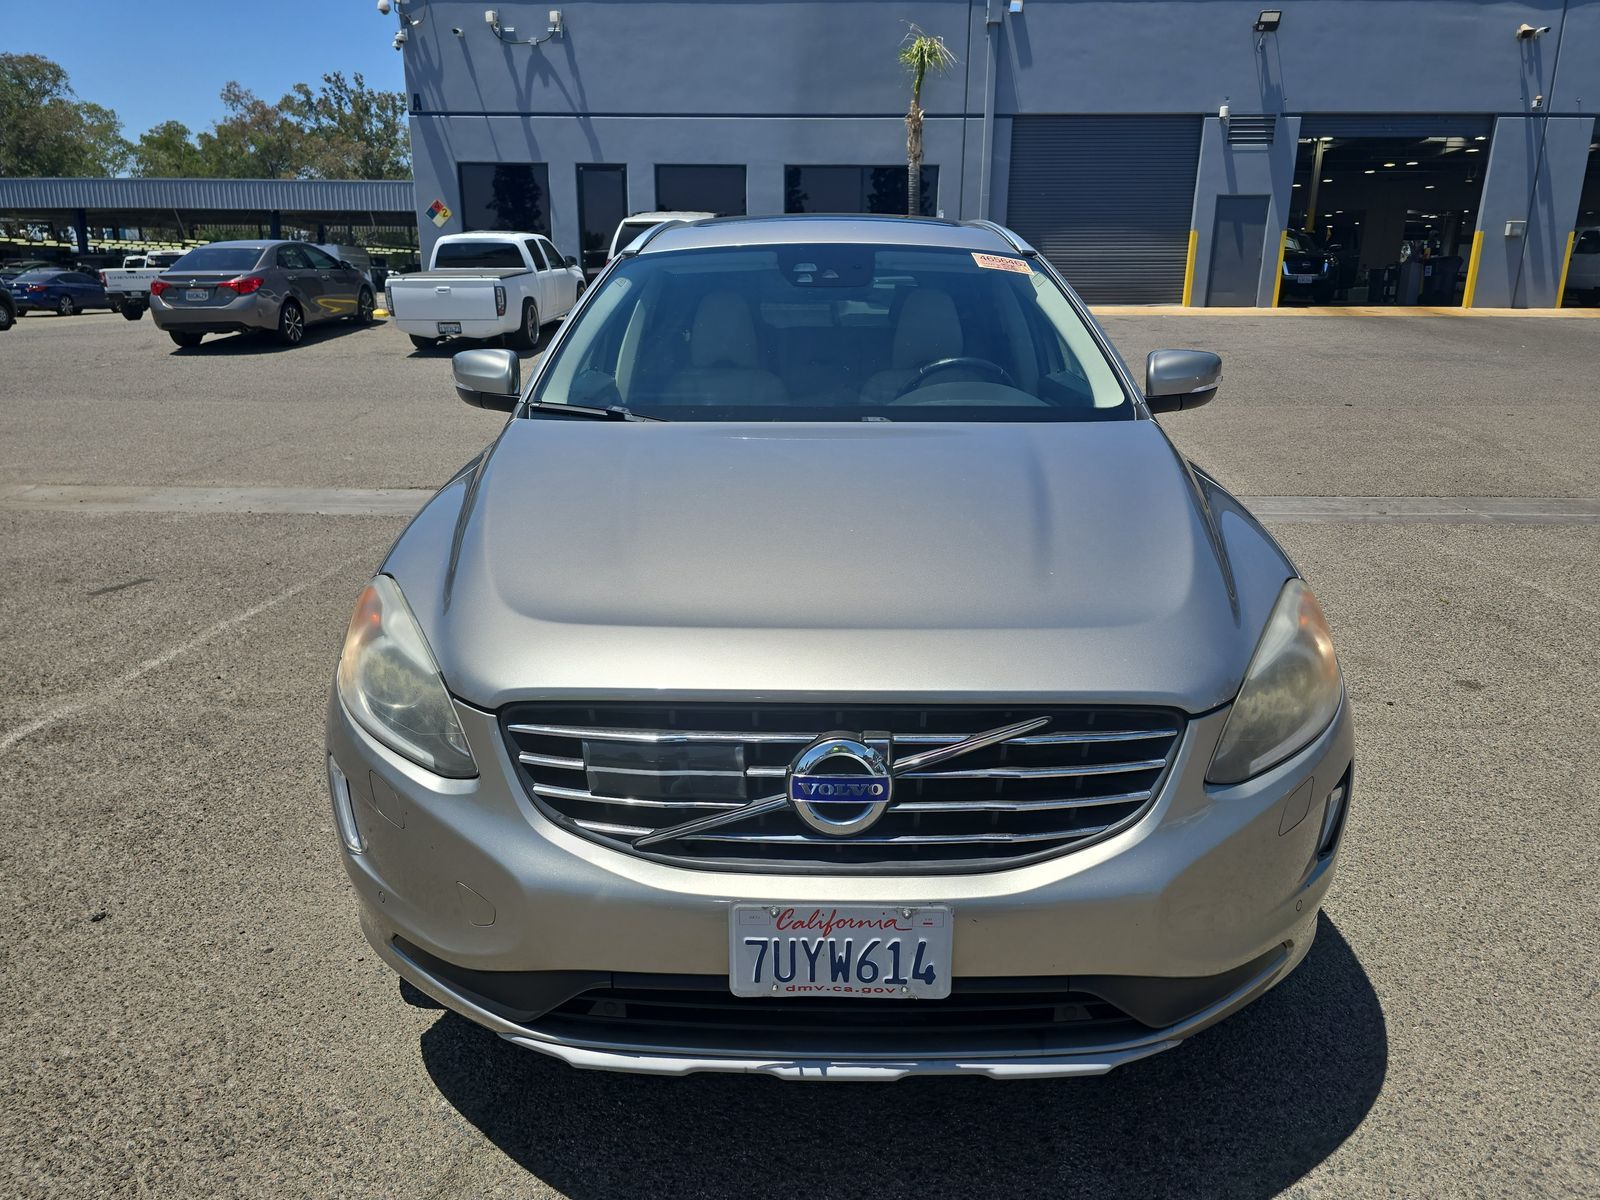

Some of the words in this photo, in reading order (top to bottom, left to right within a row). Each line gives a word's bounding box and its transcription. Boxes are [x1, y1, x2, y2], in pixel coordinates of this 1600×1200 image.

[413, 93, 422, 110] A
[442, 208, 448, 217] 2
[798, 783, 884, 795] VOLVO
[776, 908, 912, 938] California
[744, 938, 937, 985] 7UYW614
[785, 984, 896, 994] dmv.ca.gov
